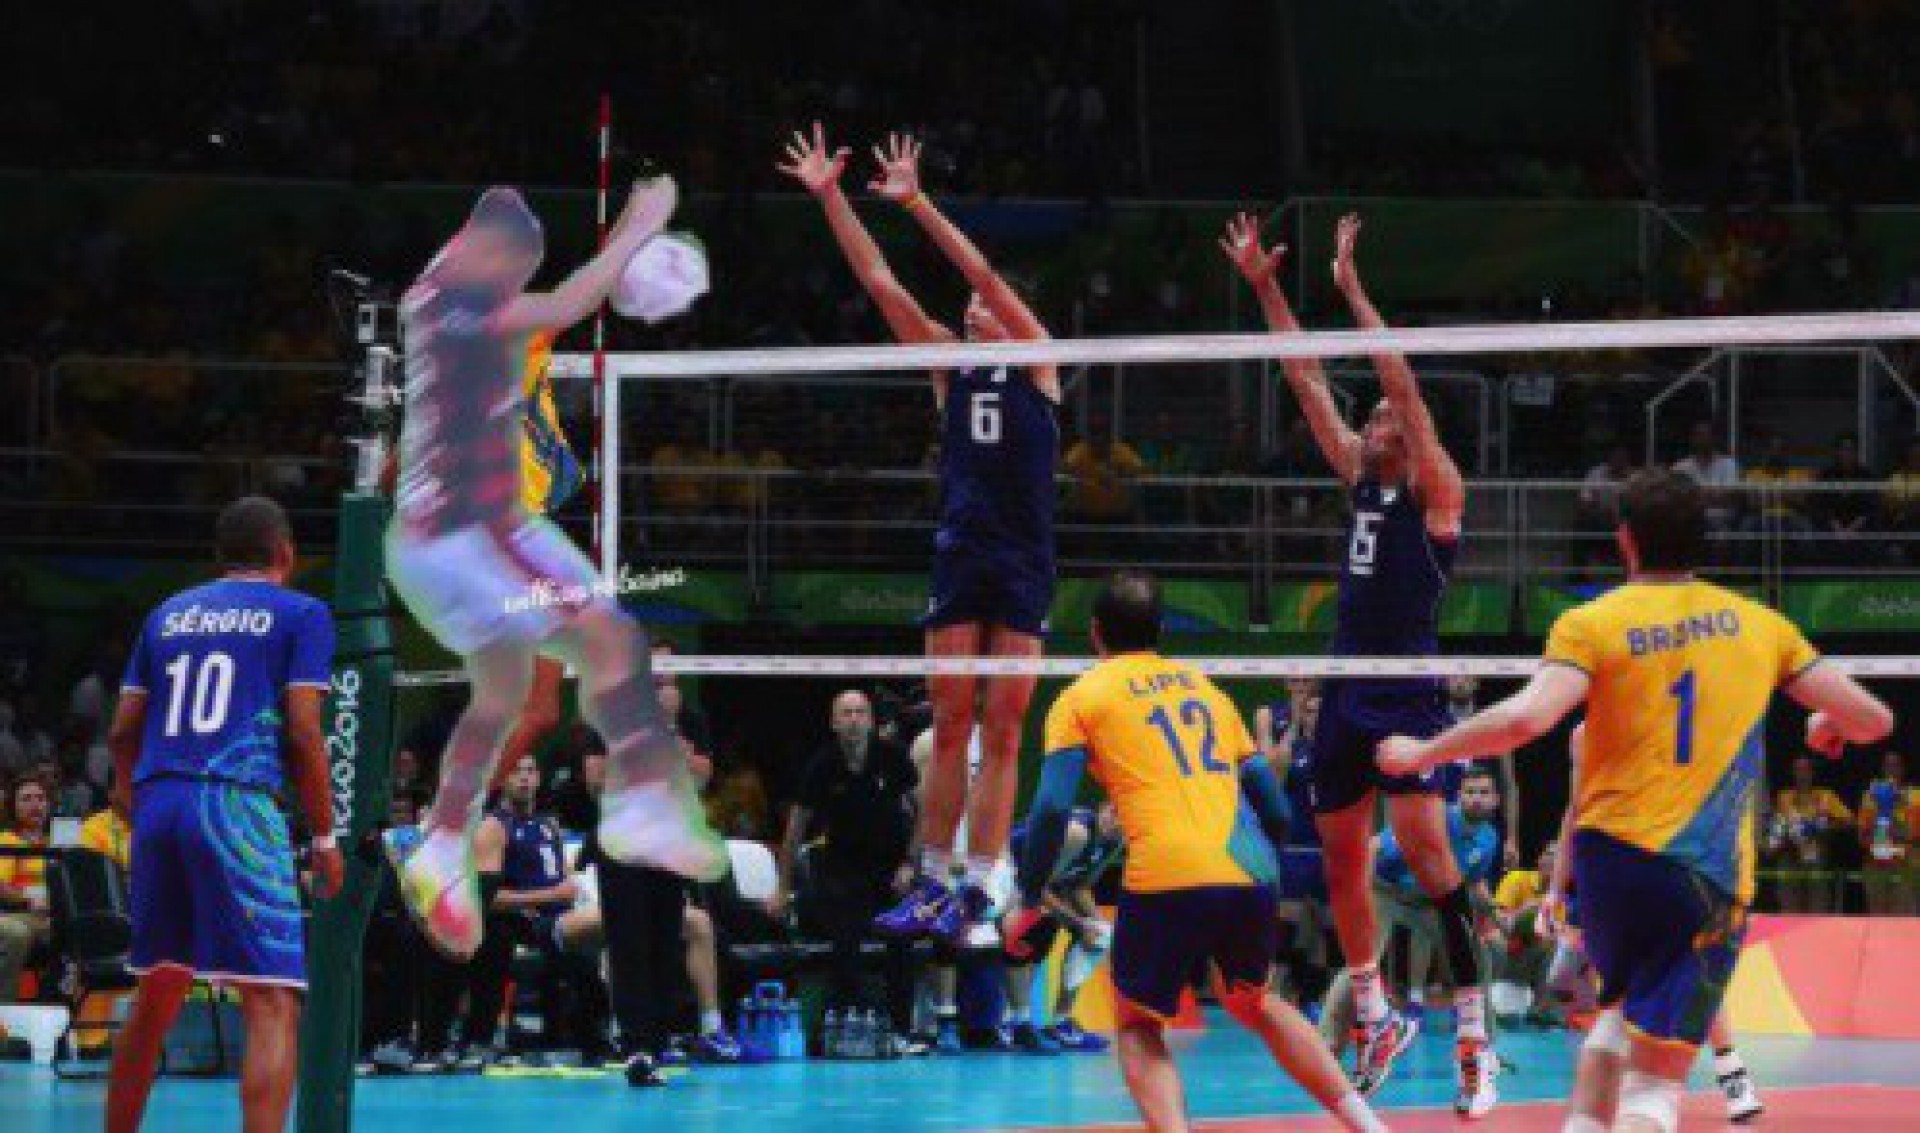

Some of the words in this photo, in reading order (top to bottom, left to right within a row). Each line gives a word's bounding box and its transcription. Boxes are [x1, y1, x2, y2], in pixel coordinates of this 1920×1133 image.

[970, 391, 1003, 444] 6
[162, 604, 274, 637] SÉRGIO
[164, 651, 236, 737] 10
[1128, 671, 1196, 697] LIPE
[1669, 666, 1697, 766] 1
[1145, 698, 1231, 777] 12
